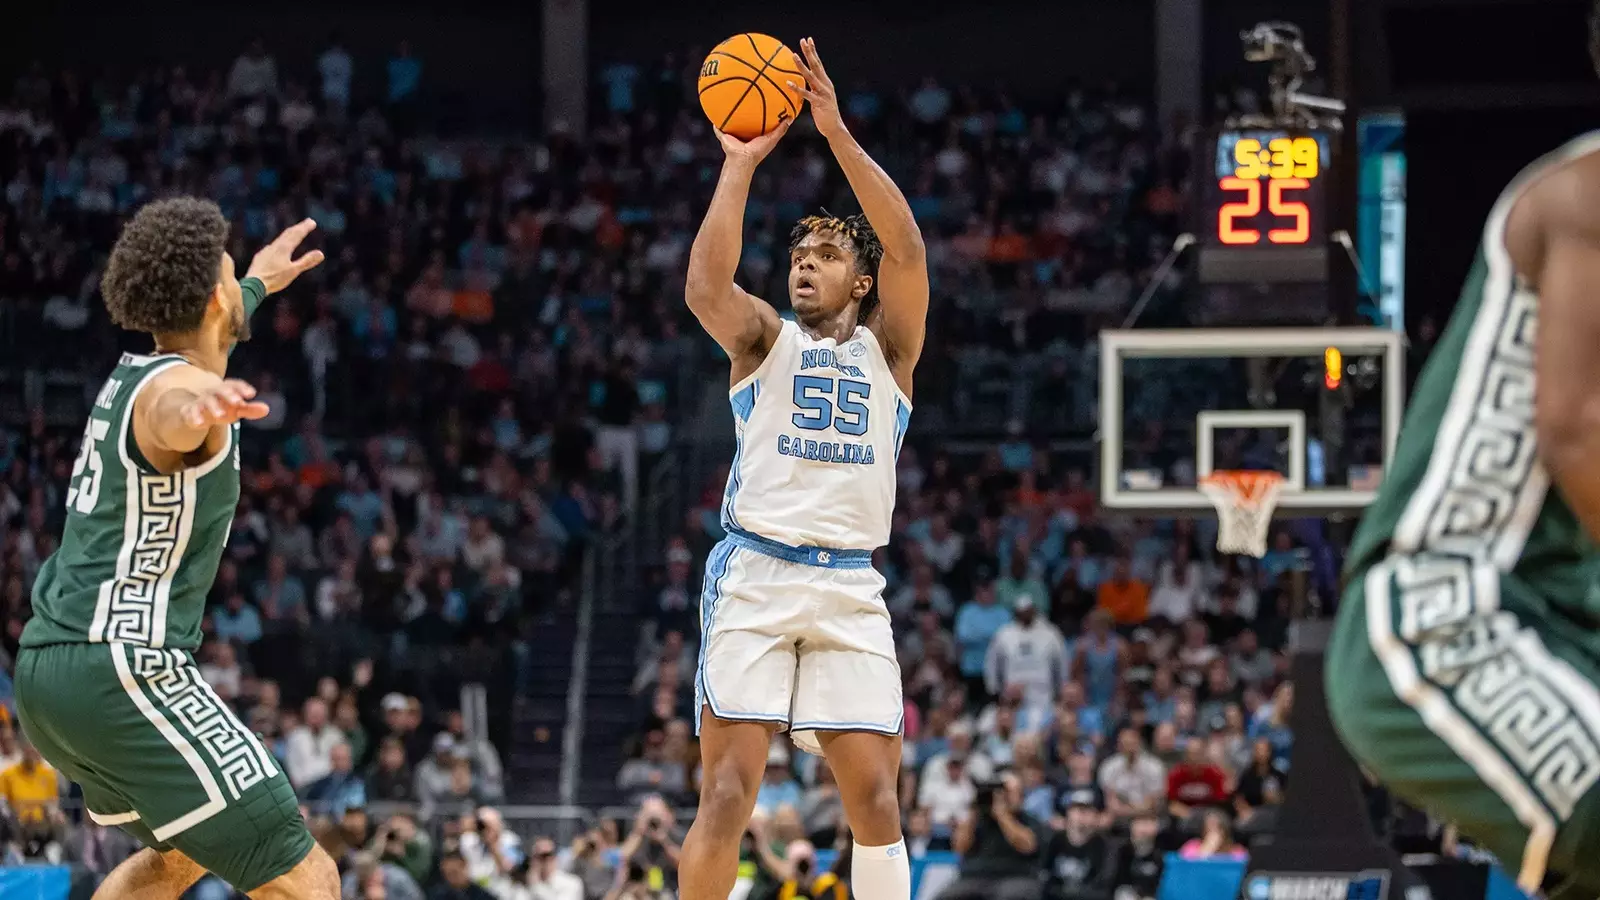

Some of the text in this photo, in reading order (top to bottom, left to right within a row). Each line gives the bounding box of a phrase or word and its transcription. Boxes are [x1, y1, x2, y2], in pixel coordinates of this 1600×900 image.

[1235, 138, 1319, 179] 5:39
[1219, 177, 1310, 244] 25
[792, 375, 872, 437] 55
[777, 434, 875, 464] CAROLINA
